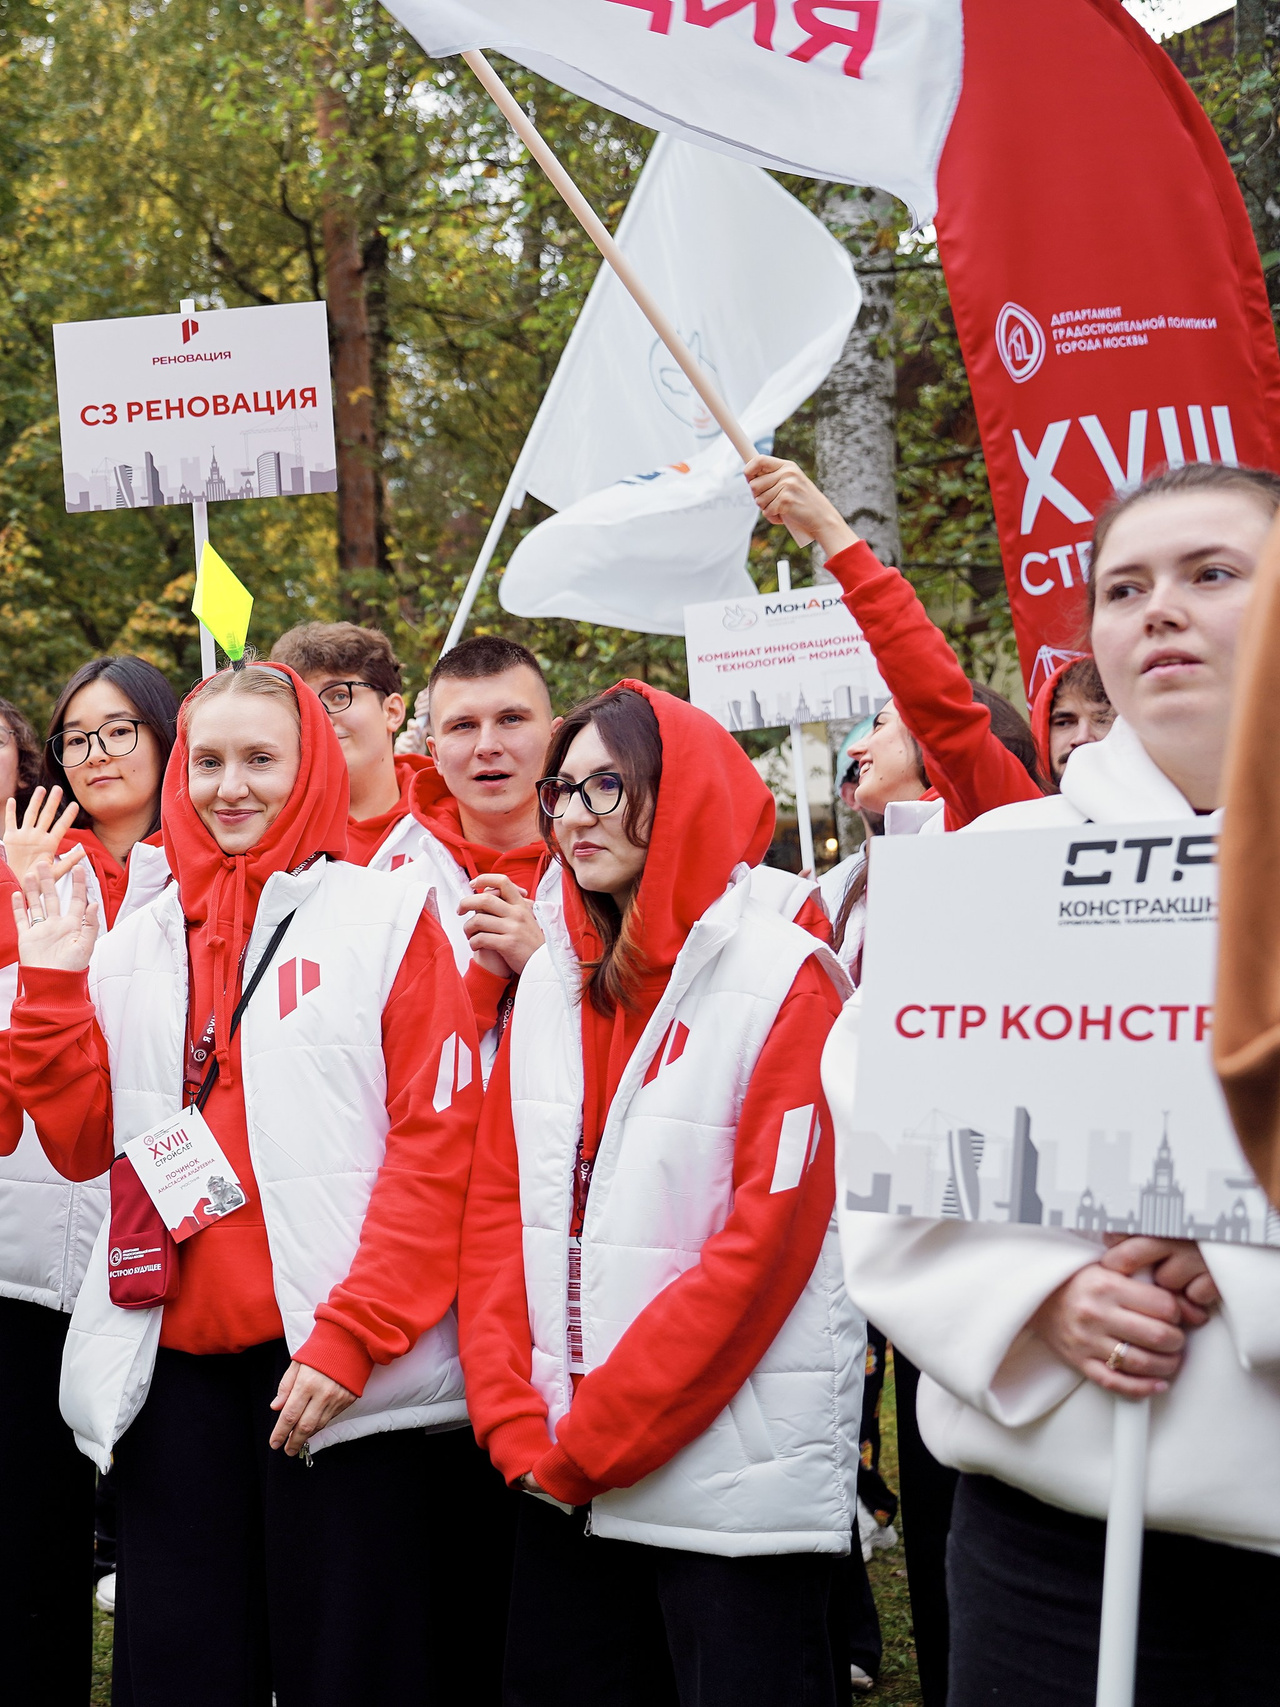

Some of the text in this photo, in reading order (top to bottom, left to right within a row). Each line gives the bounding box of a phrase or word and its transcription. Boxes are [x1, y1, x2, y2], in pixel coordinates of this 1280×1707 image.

[1050, 306, 1122, 327] ДЕПАРТАМЕНТ
[1052, 315, 1218, 341] ГРАДОСТРОИТЕЛЬНОЙ ПОЛИТИКИ
[1055, 333, 1149, 355] ГОРОДА МОСКВЫ
[152, 351, 232, 365] РЕНОВАЦИЯ
[127, 386, 318, 424] РЕНОВАЦИЯ
[697, 647, 761, 664] КОМБИНАТ
[716, 653, 796, 673] ТЕХНОЛОГИЙ
[809, 646, 861, 661] МОНАРХ
[895, 1004, 987, 1039] СТР
[148, 1128, 189, 1160] XVIII
[157, 1158, 216, 1194] АНАСТАСИЯ АНДРЕЕВНА
[165, 1158, 200, 1181] ПОЧИНОК
[134, 1263, 162, 1273] БУДУЩЕЕ
